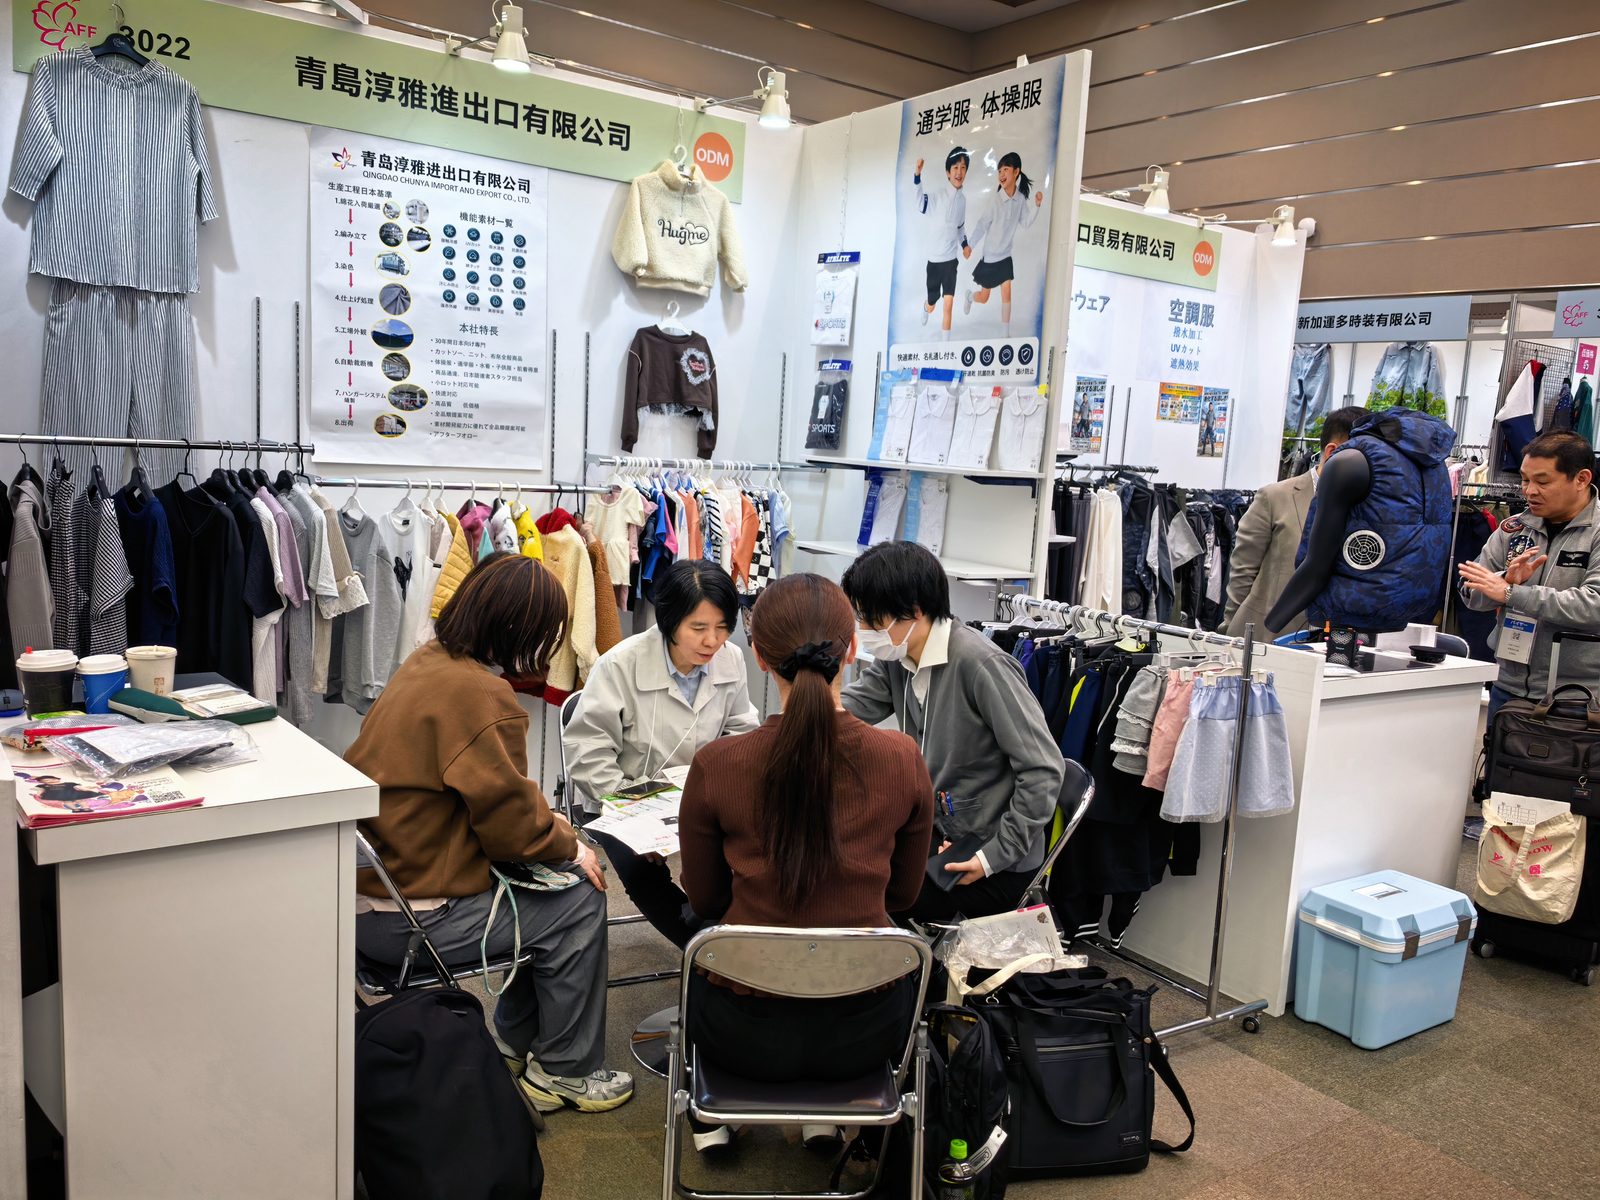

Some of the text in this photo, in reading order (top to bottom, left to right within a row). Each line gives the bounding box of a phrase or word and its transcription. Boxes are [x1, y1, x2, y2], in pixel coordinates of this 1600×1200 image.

[63, 21, 97, 39] AFF
[119, 25, 191, 61] 3022
[294, 54, 632, 153] 青島淳雅進出口有限公司
[916, 78, 1042, 137] 通学服 体操服
[696, 147, 729, 167] ODM
[360, 150, 531, 195] 青岛淳雅进出口有限公司
[327, 182, 393, 199] 生産工程日本基準
[362, 170, 399, 183] QINGDAO
[400, 176, 430, 188] CHUNYA
[430, 181, 459, 193] IMPORT
[459, 186, 475, 195] AND
[476, 189, 502, 200] EXPORT
[517, 195, 532, 205] LTD.
[459, 212, 514, 229] 機能素材一覧
[334, 229, 367, 241] 2.編み立て
[658, 218, 707, 245] Hug me
[1076, 223, 1176, 261] 口貿易有限公司
[334, 262, 355, 271] 3.染色
[1193, 252, 1213, 266] ODM
[334, 294, 374, 305] 4.仕上げ処理
[1168, 298, 1215, 329] 空調服
[1297, 311, 1432, 330] 新加運多時装有限公司
[1574, 311, 1589, 319] AFF
[334, 326, 367, 336] 5.工場外観
[459, 322, 499, 337] 本社特長
[811, 423, 836, 433] SPORTS
